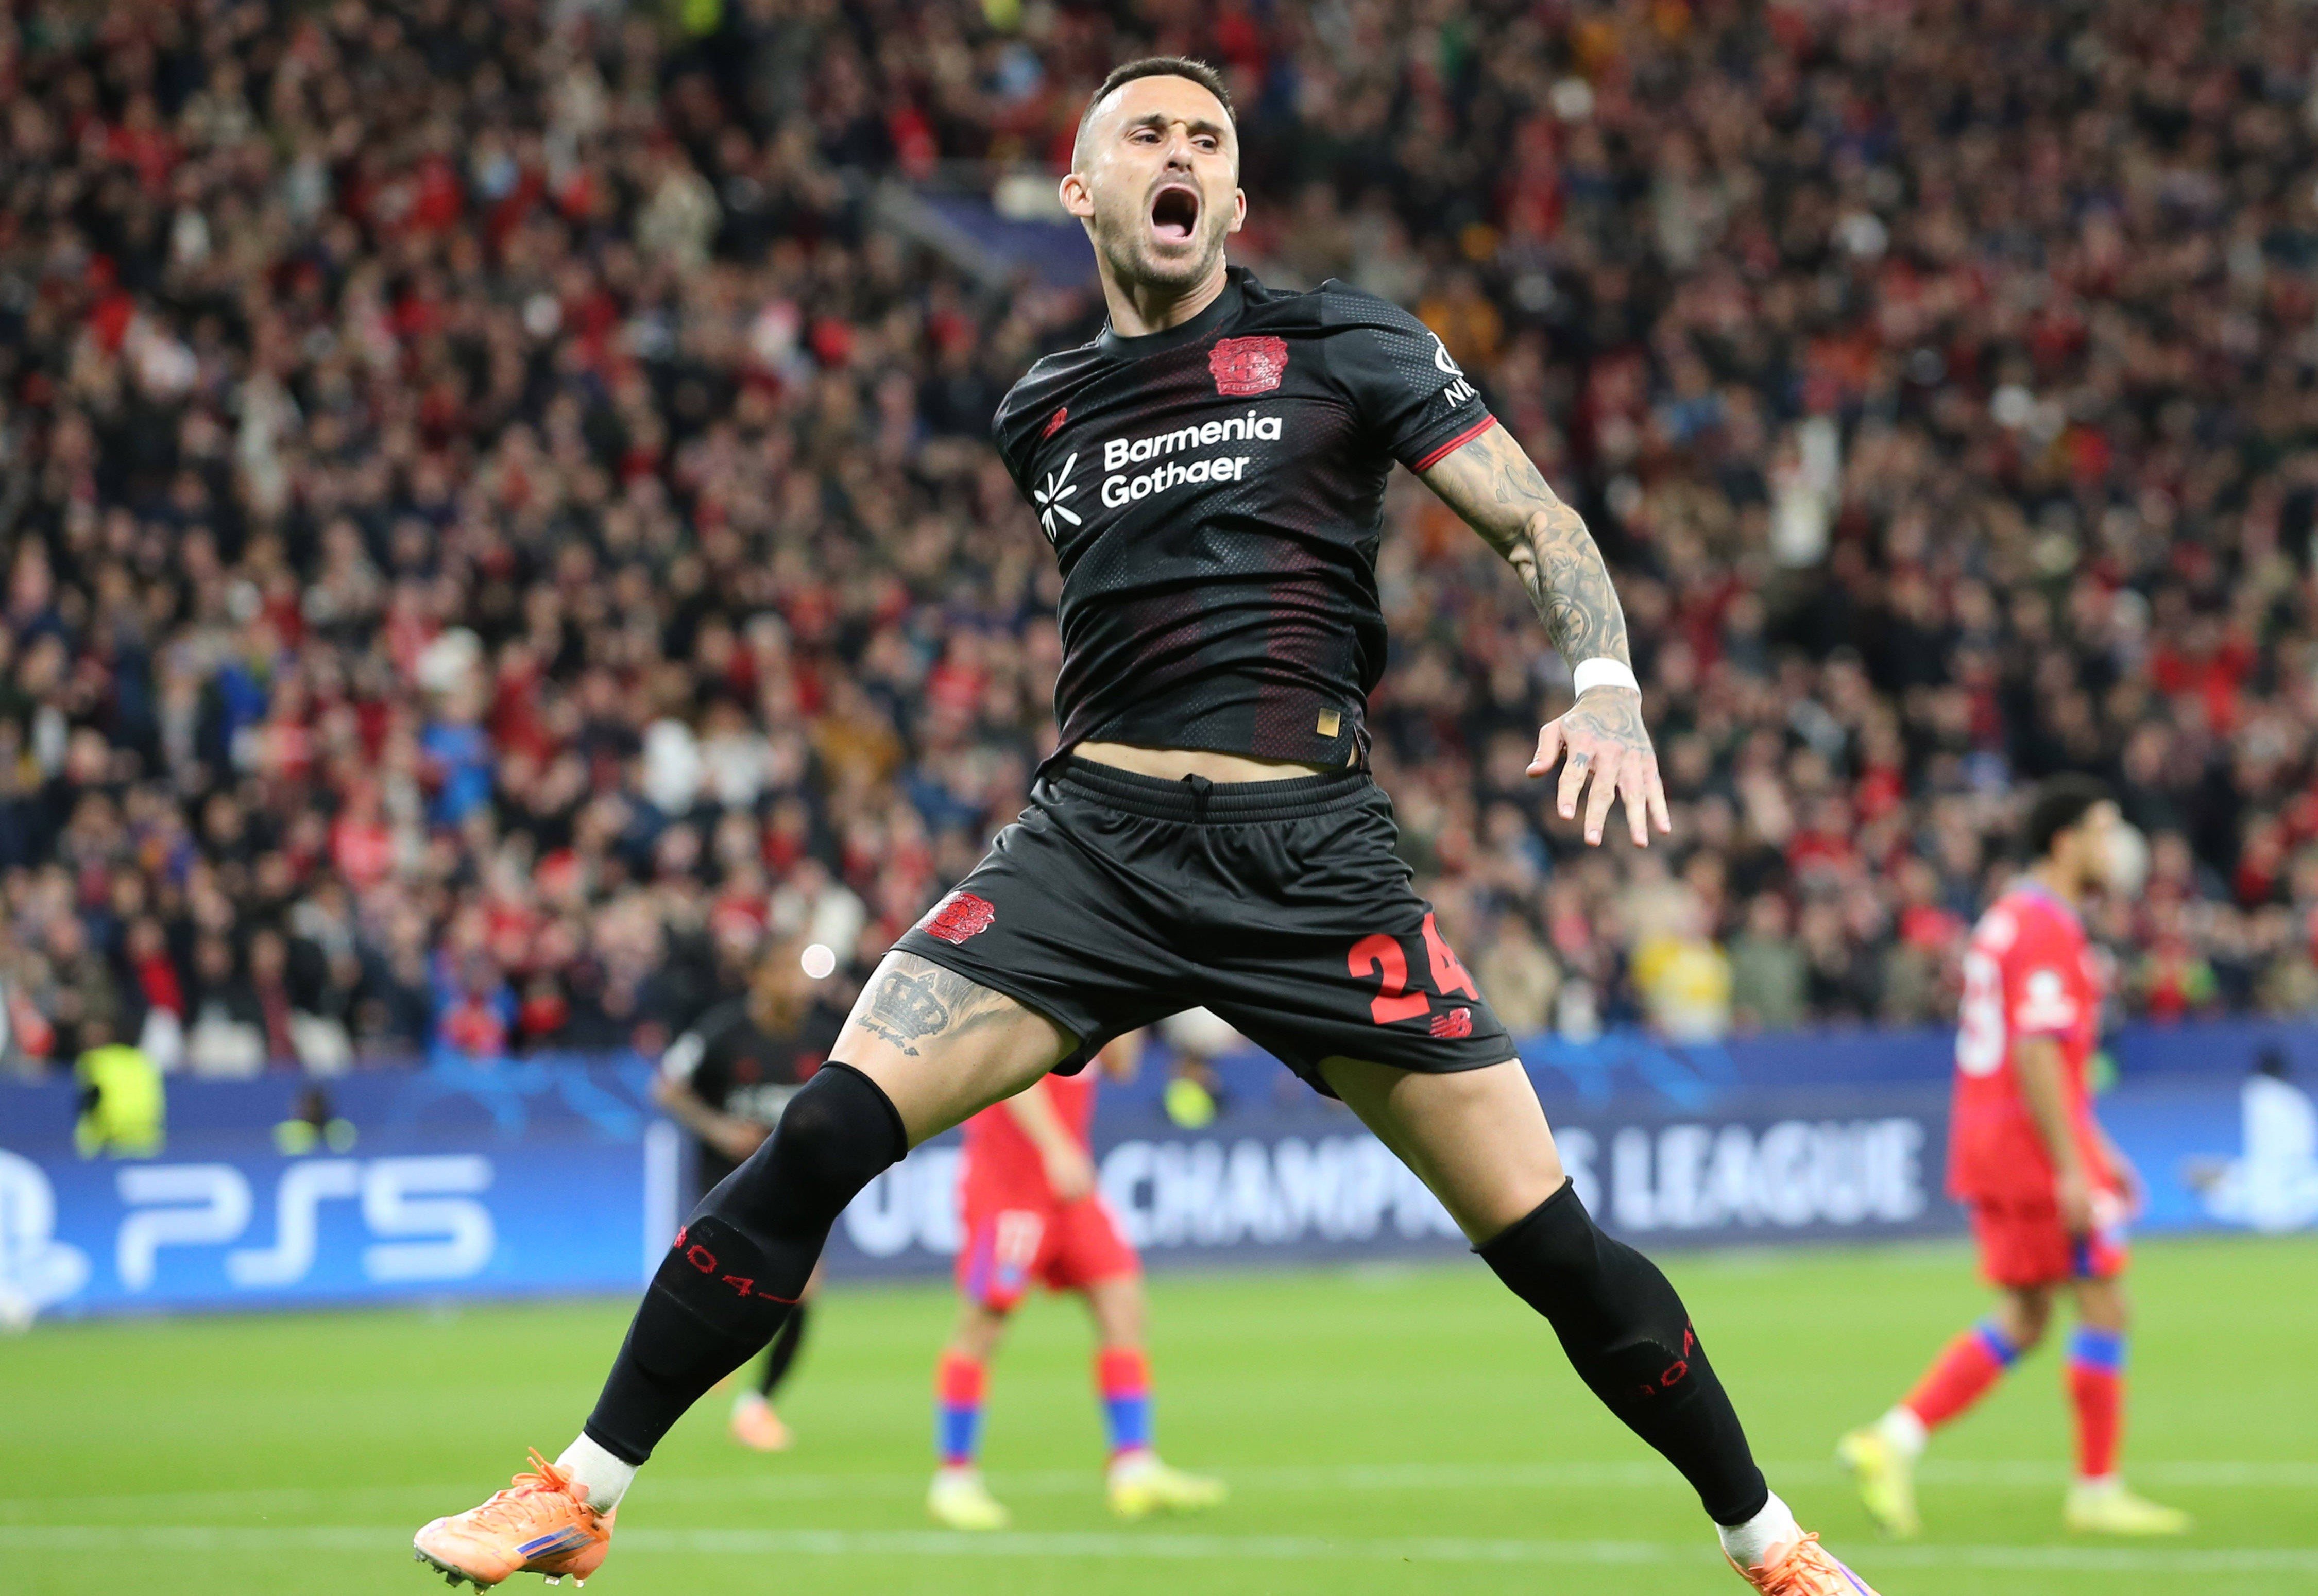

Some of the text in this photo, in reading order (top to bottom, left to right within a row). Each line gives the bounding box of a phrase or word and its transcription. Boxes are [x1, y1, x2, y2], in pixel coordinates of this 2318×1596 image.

[1101, 453, 1250, 509] Gothaer
[1103, 410, 1282, 472] Barmenia
[1347, 912, 1479, 1025] 24
[115, 1154, 495, 1291] PS5
[1612, 1119, 1927, 1231] LEAGUE
